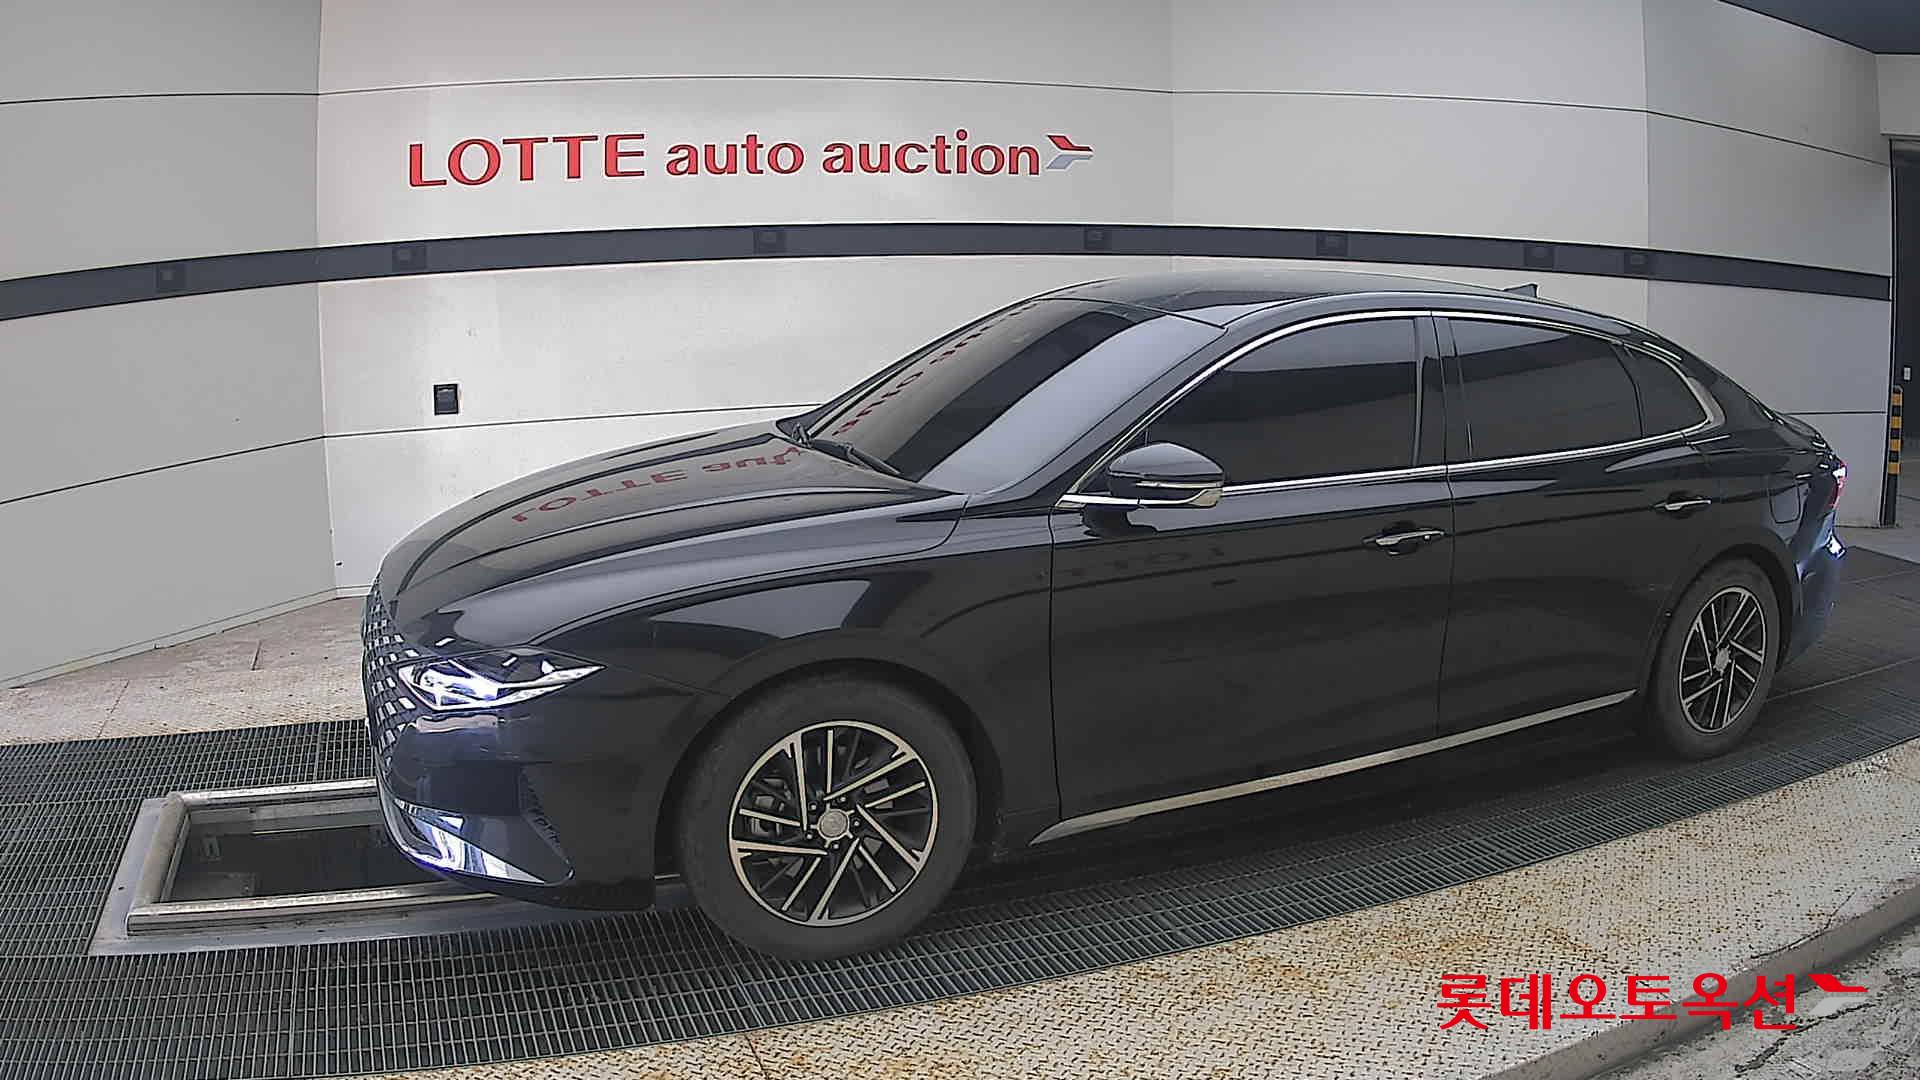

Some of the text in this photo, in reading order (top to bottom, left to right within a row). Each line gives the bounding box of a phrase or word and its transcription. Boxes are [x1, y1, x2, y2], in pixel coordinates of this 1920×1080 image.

[408, 129, 1041, 187] LOTTE auto auction
